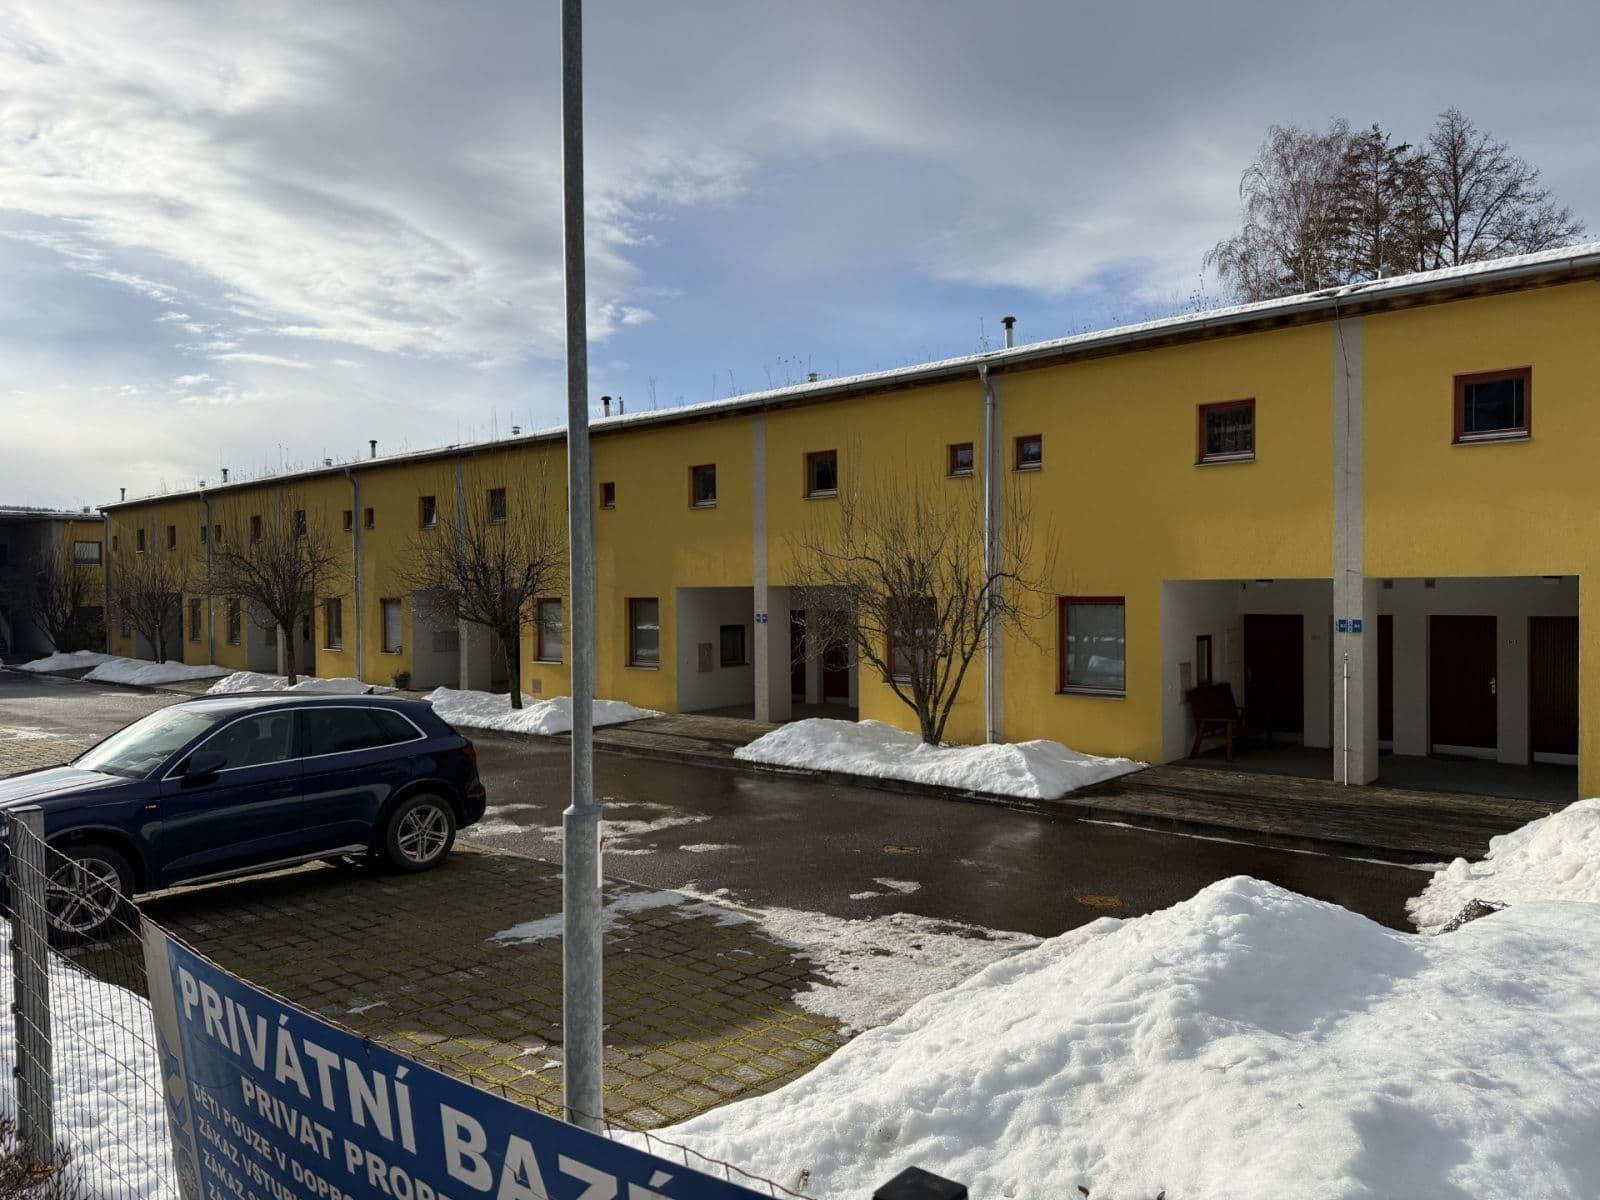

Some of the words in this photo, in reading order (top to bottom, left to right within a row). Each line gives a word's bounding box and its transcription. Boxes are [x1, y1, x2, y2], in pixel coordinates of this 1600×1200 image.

[179, 966, 416, 1155] PRIVÁTNÍ
[440, 1103, 678, 1200] BAZ
[198, 1115, 240, 1168] ZÁKAZ
[222, 1107, 272, 1161] POUZE
[274, 1146, 286, 1171] V
[241, 1076, 333, 1160] PRIVAT
[344, 1139, 456, 1200] PROP
[202, 1148, 246, 1200] ZÁKAZ
